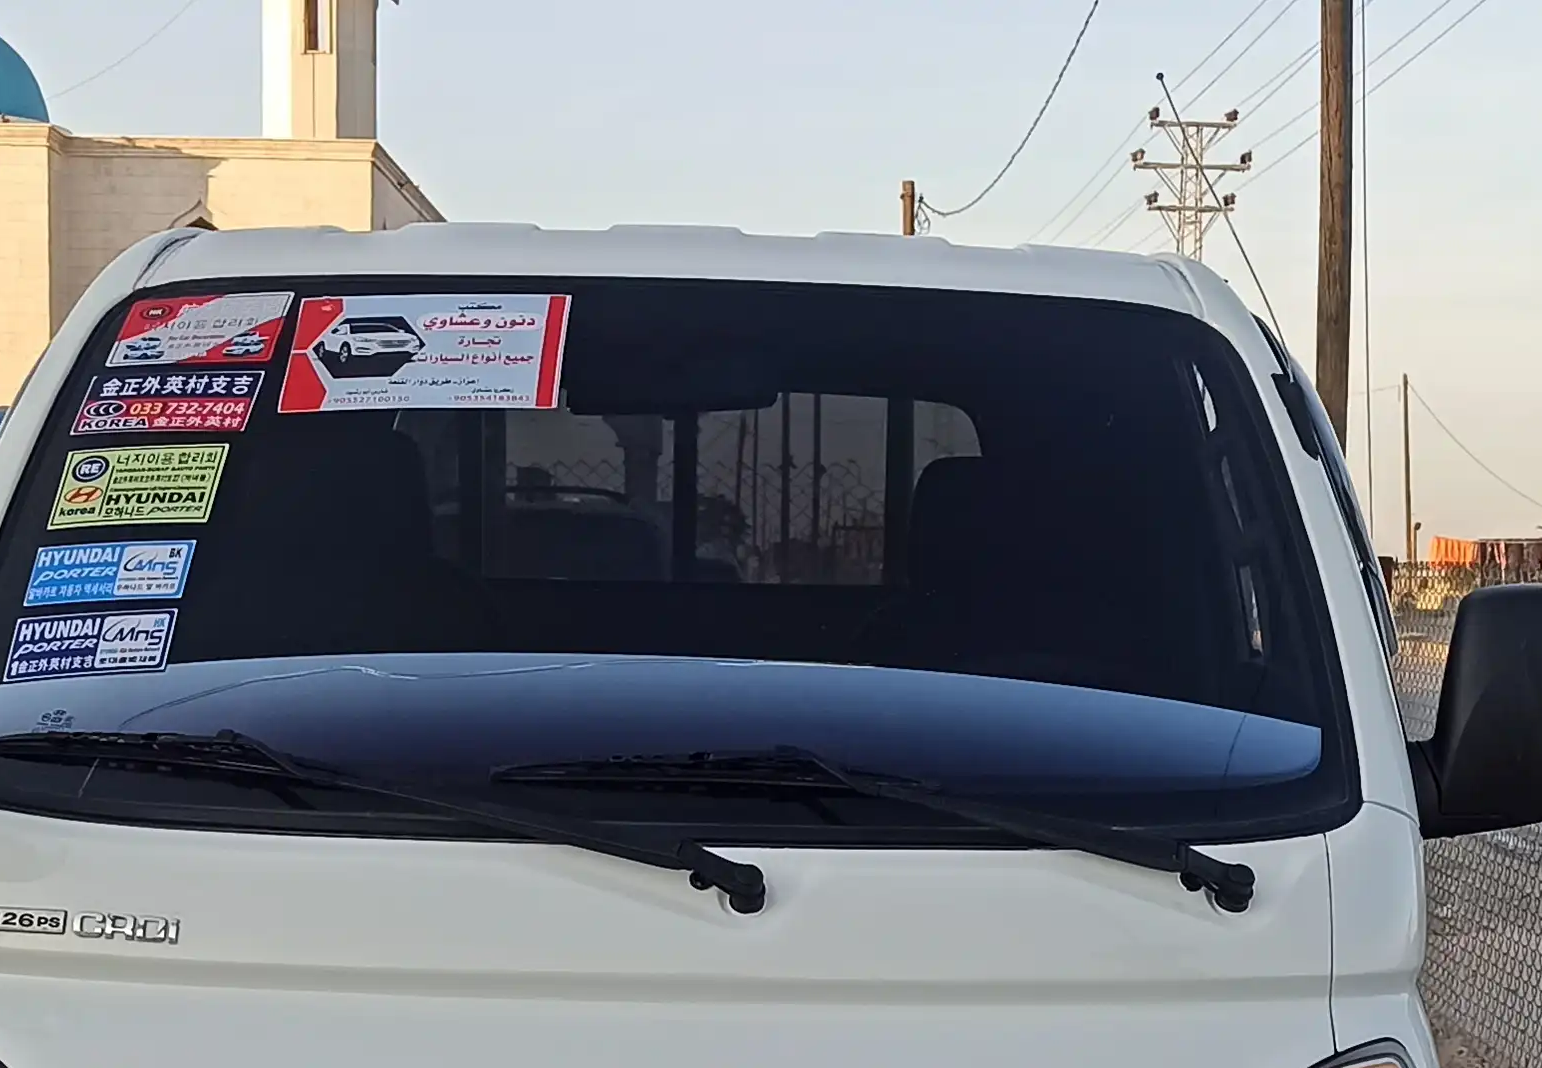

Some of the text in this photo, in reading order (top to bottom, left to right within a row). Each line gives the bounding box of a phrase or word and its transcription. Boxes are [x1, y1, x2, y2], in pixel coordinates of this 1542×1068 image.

[458, 302, 502, 312] مكتب
[423, 313, 491, 331] وعشاوي
[457, 335, 501, 348] تجارة
[416, 352, 469, 365] السيارات
[503, 354, 534, 365] جميع
[130, 401, 245, 415] 033 732-7404
[81, 417, 147, 430] KOREA
[79, 462, 101, 475] RE
[105, 491, 206, 506] HYUNDAI
[59, 506, 95, 517] korea
[146, 505, 203, 516] PORTER
[38, 547, 121, 567] HYUNDAI
[169, 548, 183, 558] BK
[33, 567, 118, 586] PORTER
[18, 618, 101, 641] HYUNDAI
[13, 638, 98, 659] PORTER
